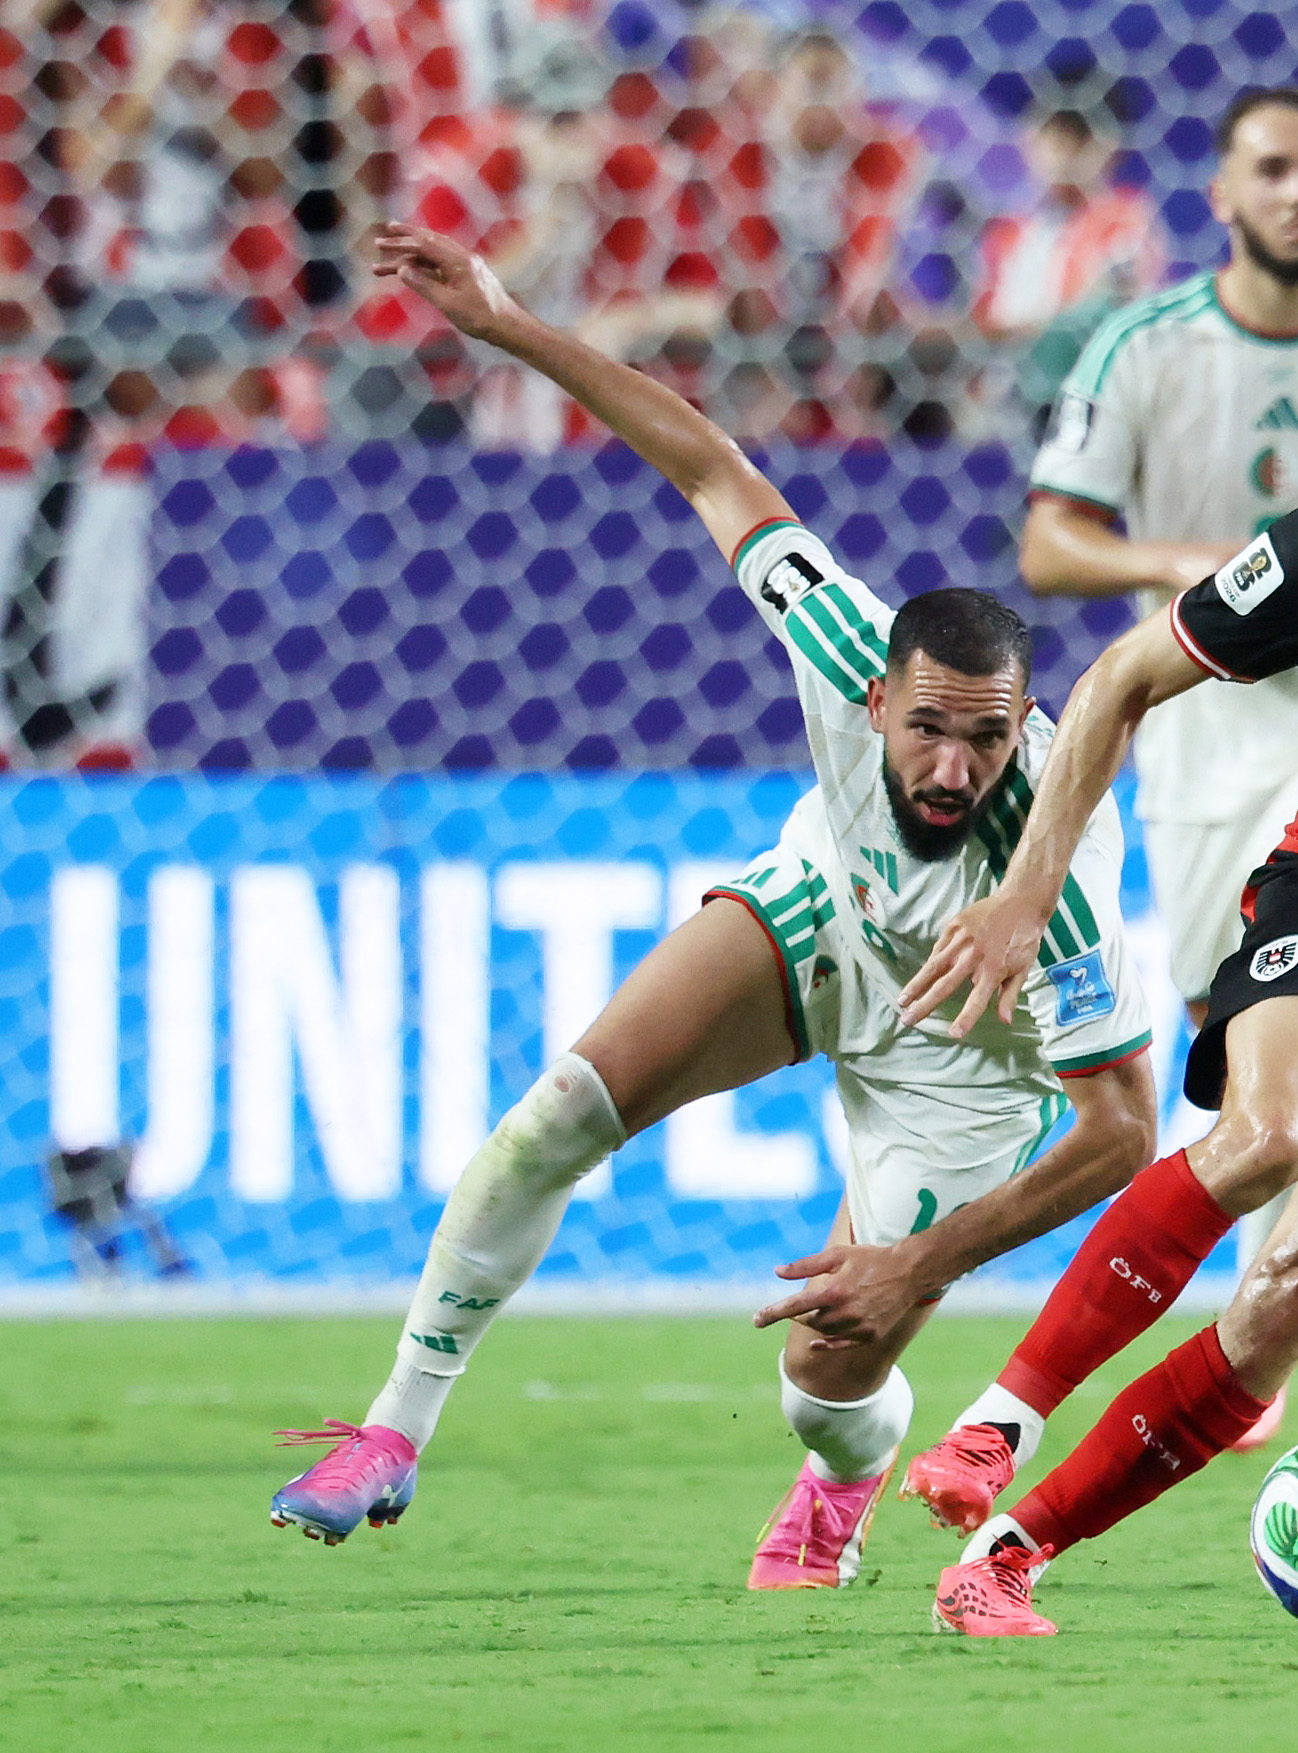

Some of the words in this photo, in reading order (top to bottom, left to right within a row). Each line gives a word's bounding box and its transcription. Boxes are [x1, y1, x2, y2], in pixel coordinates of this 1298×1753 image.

[50, 862, 848, 1202] UNITE
[437, 1290, 501, 1311] FAF
[1109, 1256, 1162, 1304] ÖFB
